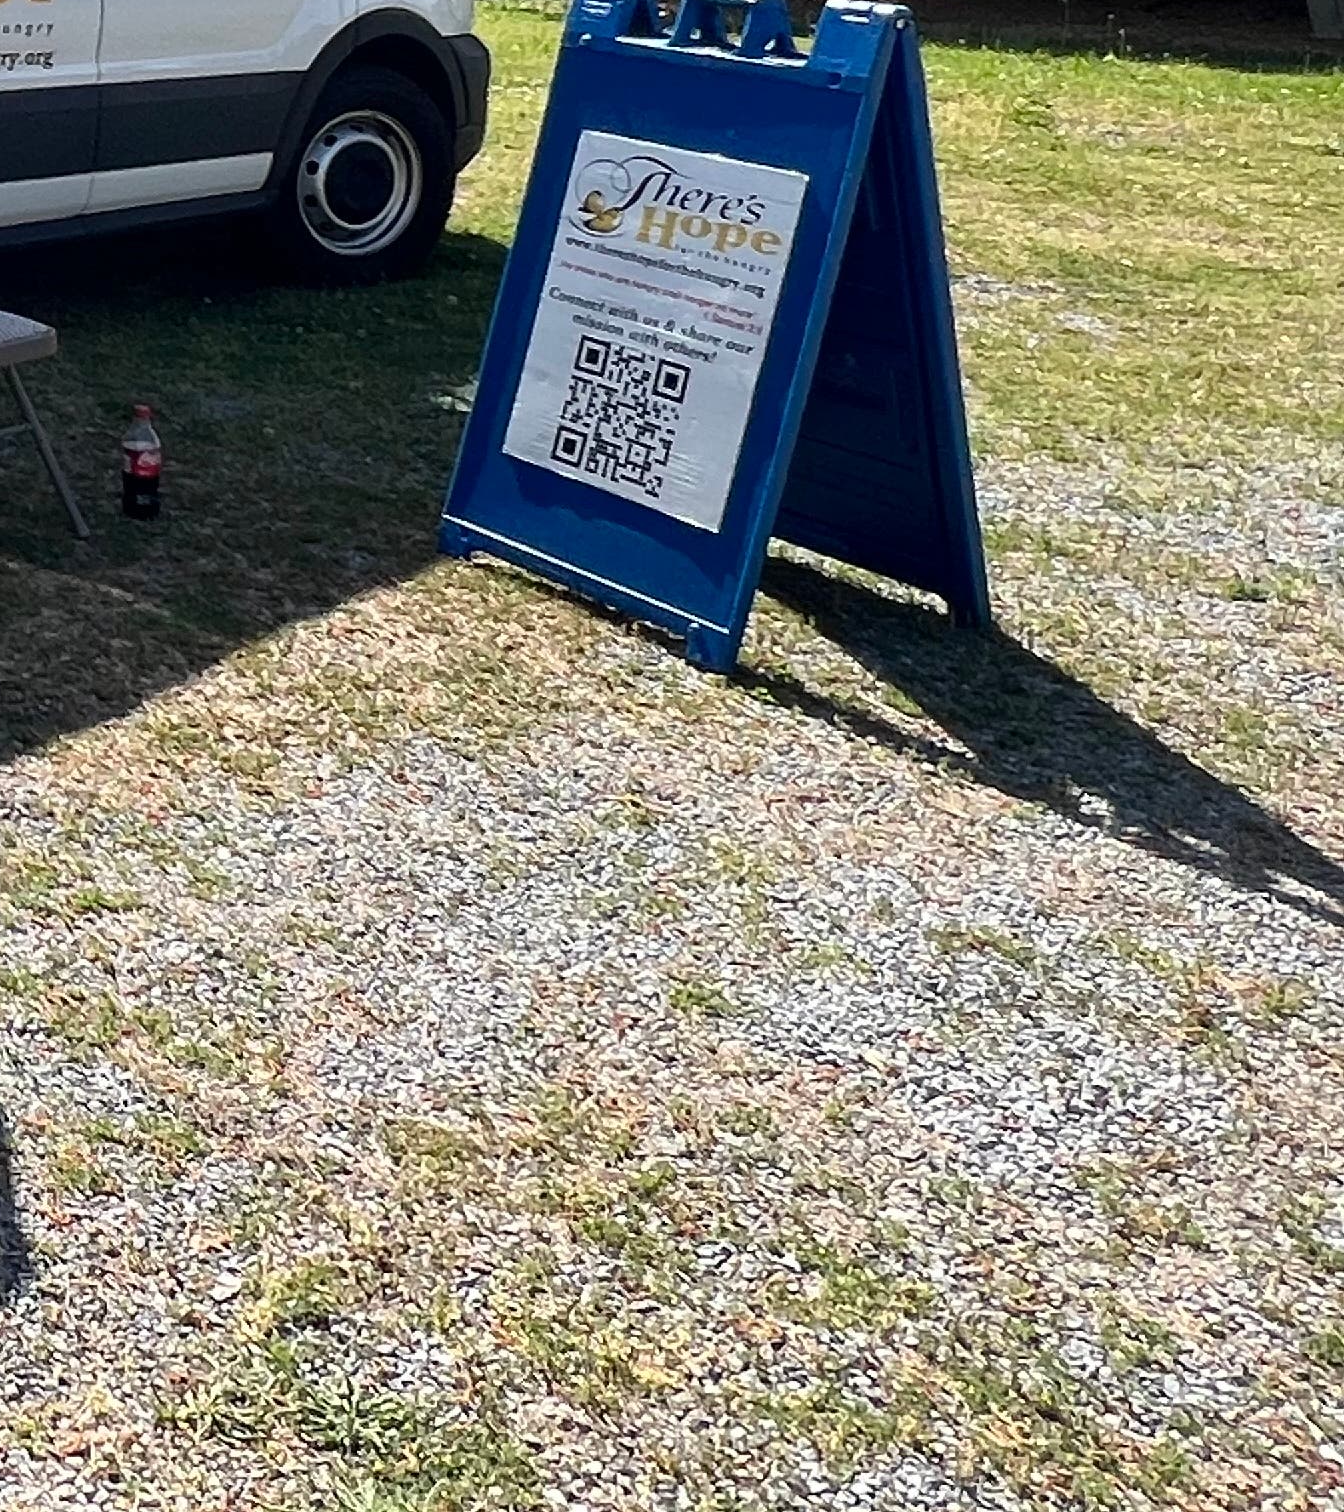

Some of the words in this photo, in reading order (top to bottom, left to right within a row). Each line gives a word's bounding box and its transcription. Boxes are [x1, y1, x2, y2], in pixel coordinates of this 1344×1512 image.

[620, 157, 766, 225] There's
[635, 205, 782, 254] Hope
[549, 287, 605, 311] Connect
[609, 307, 638, 322] with
[642, 316, 660, 328] us
[663, 319, 676, 333] &
[681, 325, 723, 346] share
[573, 314, 624, 336] mission
[629, 330, 659, 347] with
